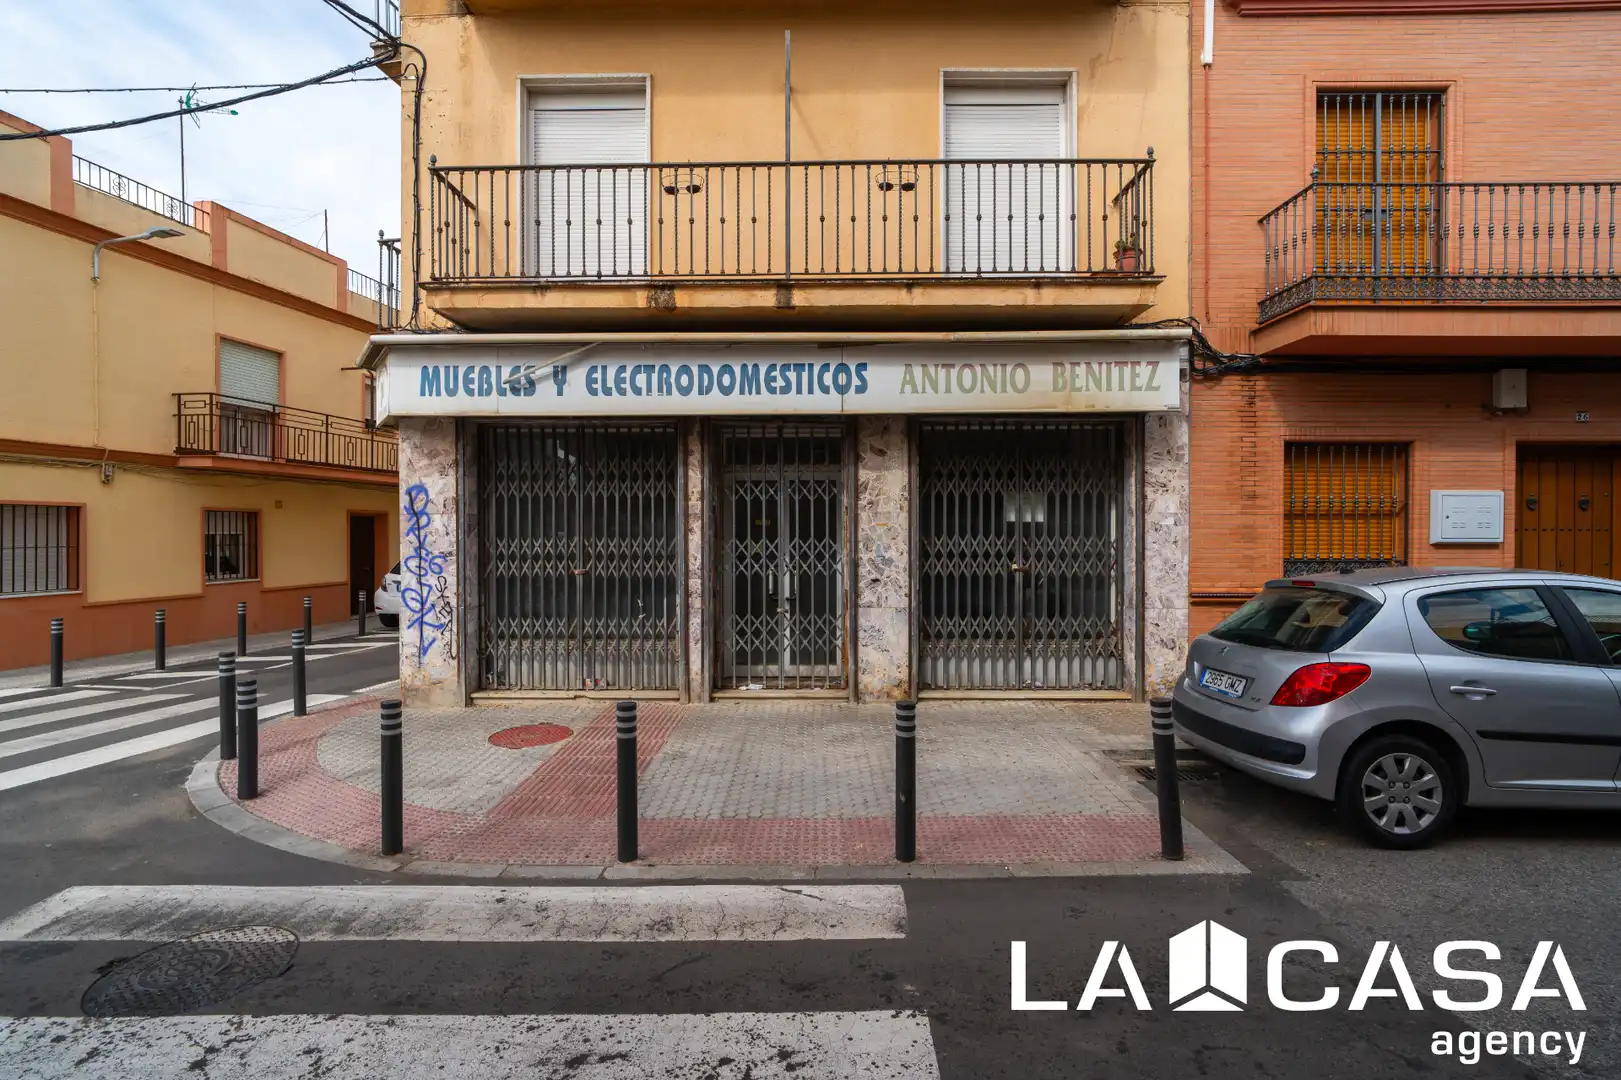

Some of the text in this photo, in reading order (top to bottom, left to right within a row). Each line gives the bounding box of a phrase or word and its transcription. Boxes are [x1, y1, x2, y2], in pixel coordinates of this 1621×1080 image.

[419, 360, 1161, 398] MUEBLES Y ELECTRODOMESTICOS ANTONIO BENITEZ
[1206, 671, 1224, 686] 2965
[1225, 677, 1242, 693] GMZ
